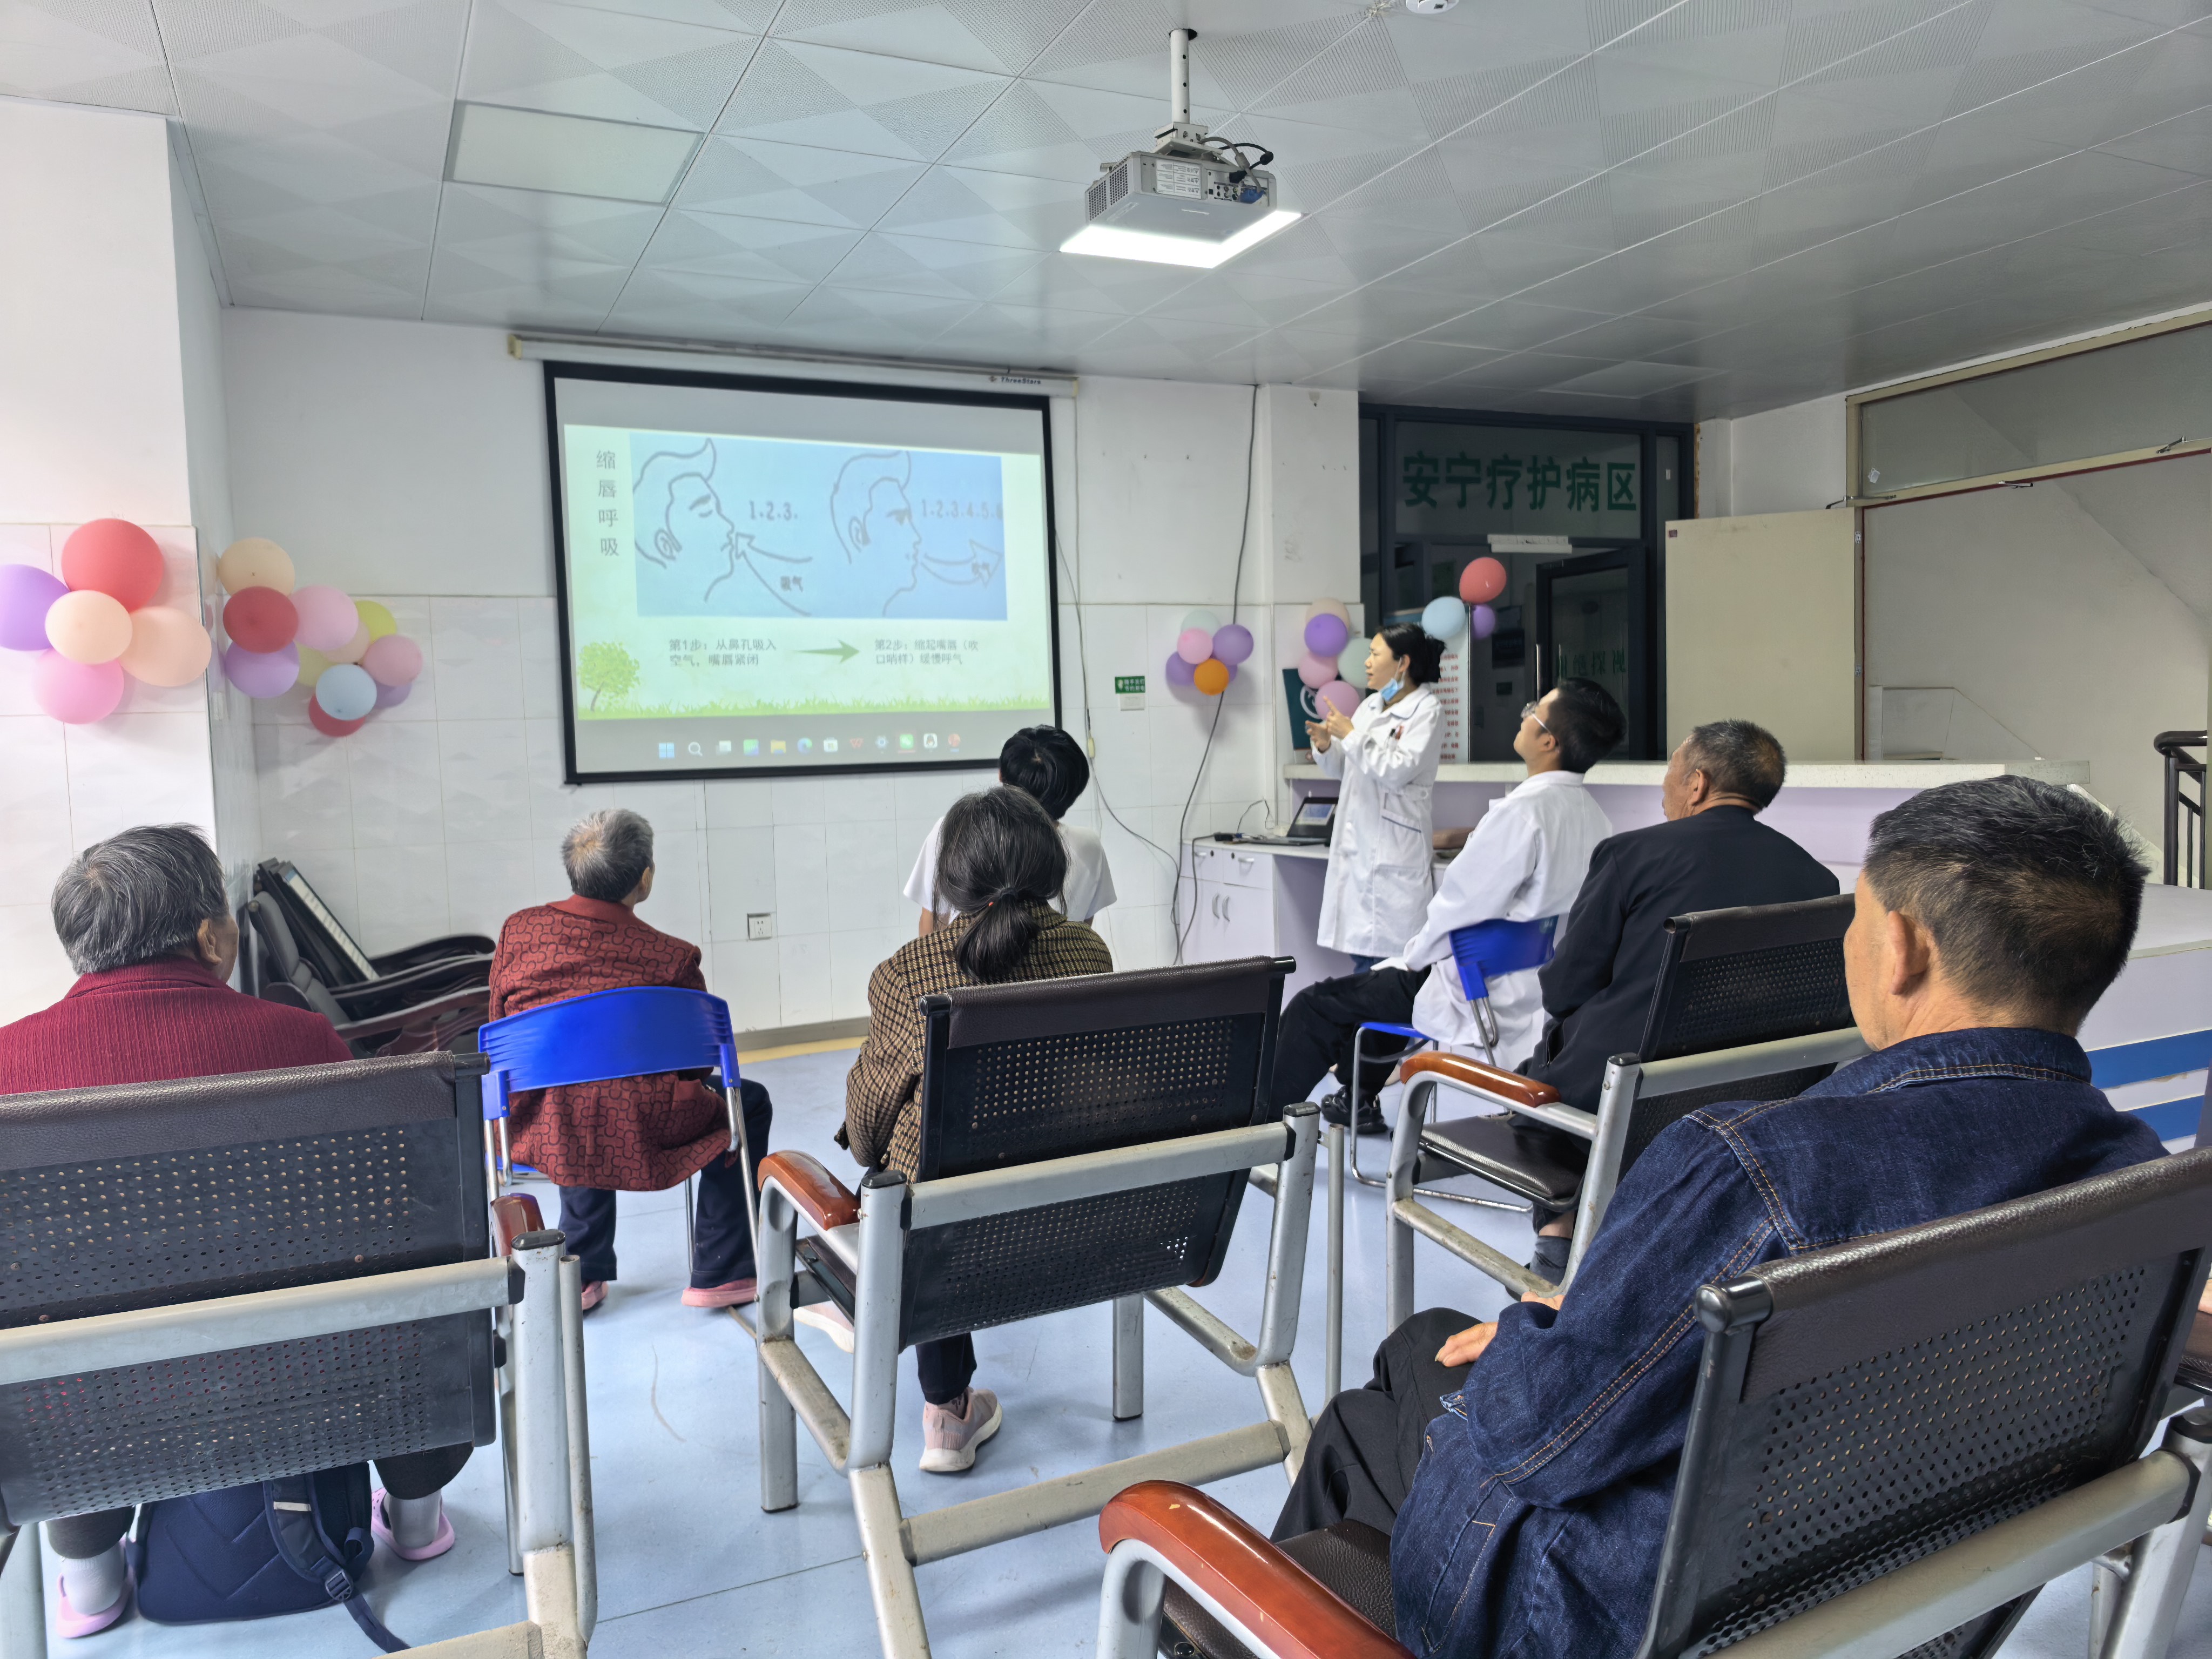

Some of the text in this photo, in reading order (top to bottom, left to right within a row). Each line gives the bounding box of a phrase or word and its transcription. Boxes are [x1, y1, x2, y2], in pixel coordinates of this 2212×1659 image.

[596, 449, 619, 557] 缩唇呼吸
[1402, 450, 1636, 511] 安宁疗护病区
